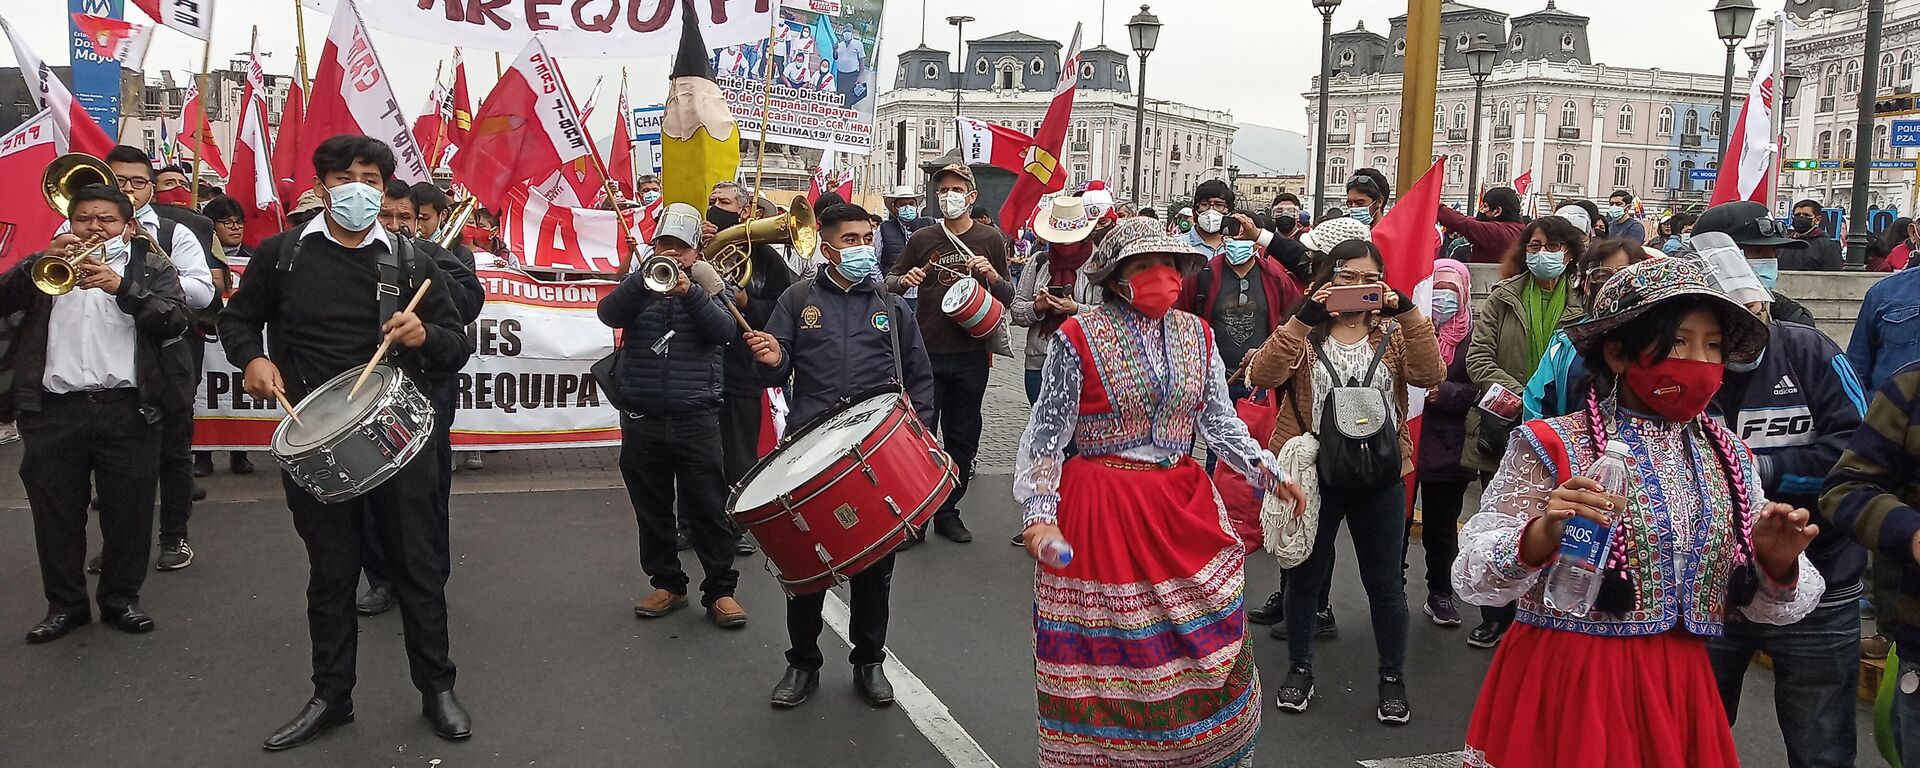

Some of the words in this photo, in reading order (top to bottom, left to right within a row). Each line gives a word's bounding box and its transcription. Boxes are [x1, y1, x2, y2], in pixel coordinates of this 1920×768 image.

[739, 92, 752, 103] de
[756, 95, 807, 111] Cmpaña
[810, 102, 858, 119] Rapayan
[799, 89, 844, 105] Distrital
[782, 125, 809, 138] LIMA
[798, 115, 818, 127] (CED
[850, 123, 873, 135] HRA)
